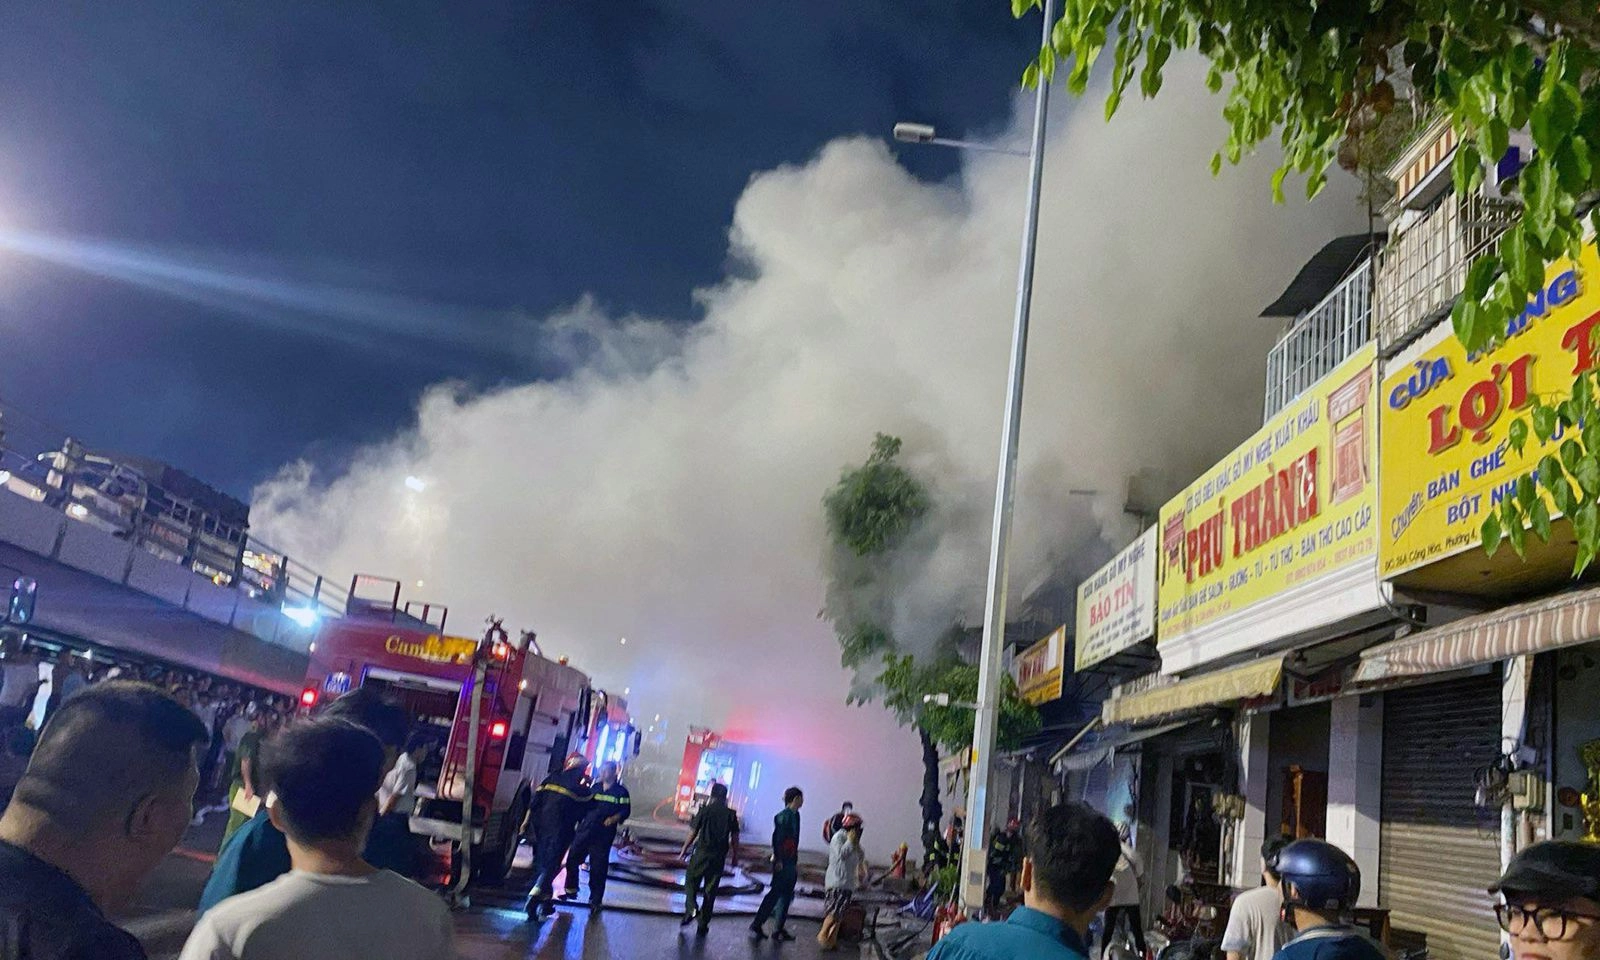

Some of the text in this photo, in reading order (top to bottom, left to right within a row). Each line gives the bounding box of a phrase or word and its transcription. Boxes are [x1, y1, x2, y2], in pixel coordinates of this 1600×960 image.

[1389, 357, 1451, 409] CỬA
[1427, 354, 1532, 456] LỢI
[1427, 469, 1460, 501] BÀN
[1447, 493, 1482, 525] BỘT
[1336, 515, 1351, 541] CAO
